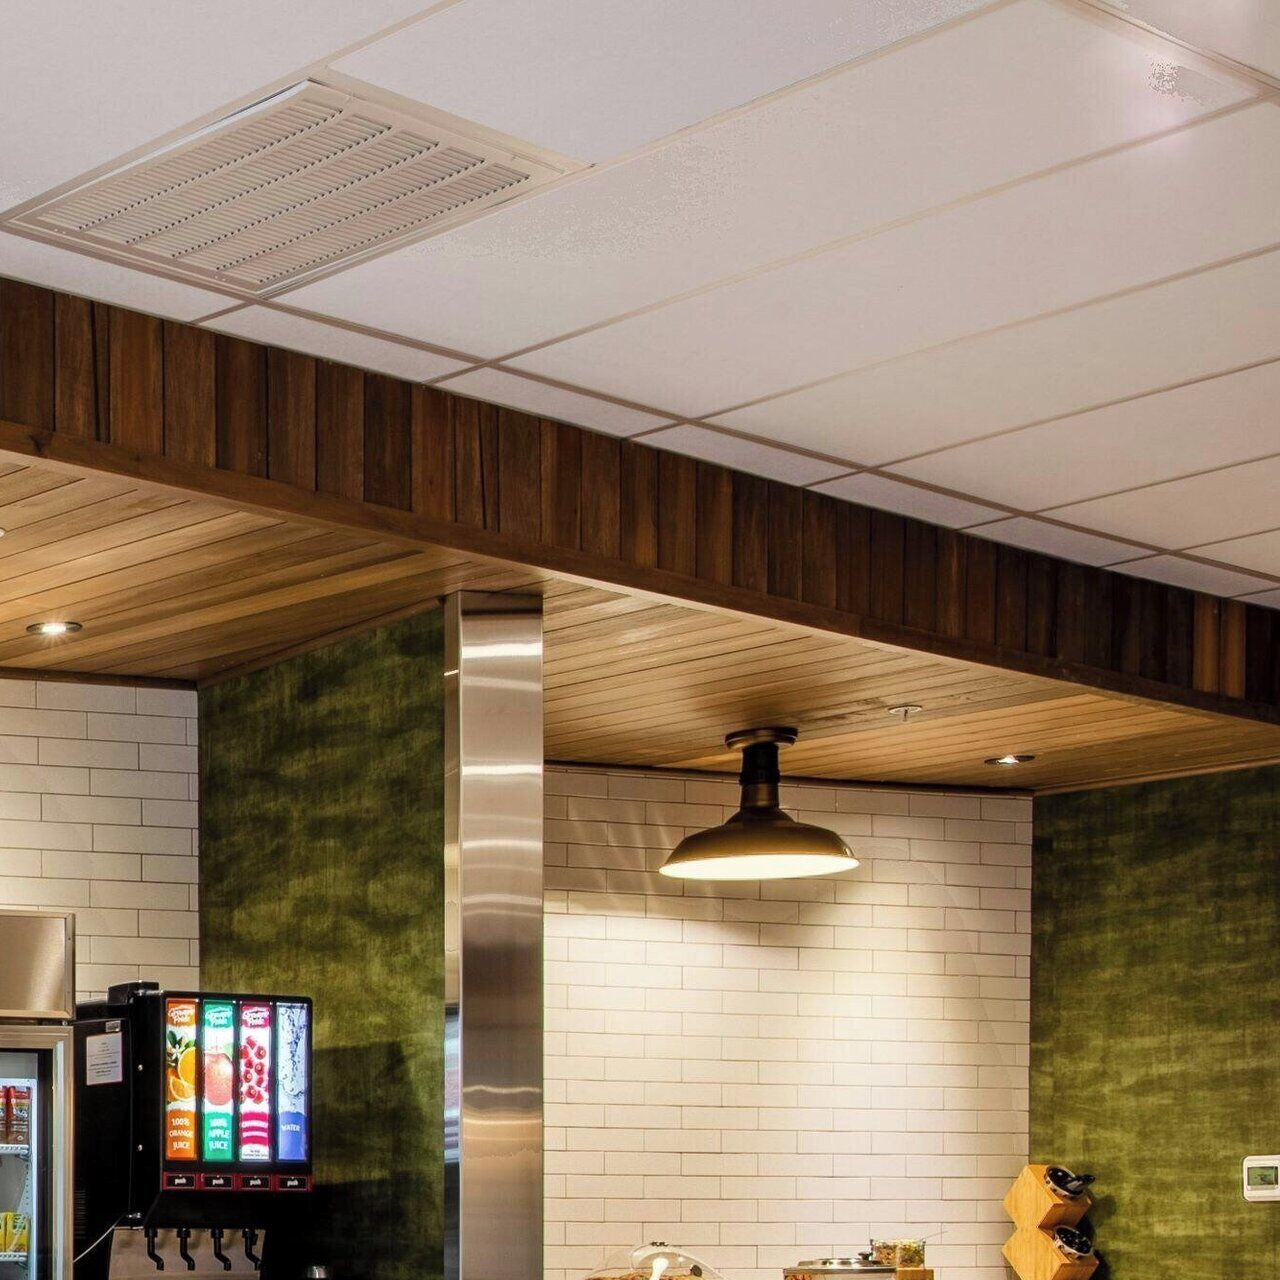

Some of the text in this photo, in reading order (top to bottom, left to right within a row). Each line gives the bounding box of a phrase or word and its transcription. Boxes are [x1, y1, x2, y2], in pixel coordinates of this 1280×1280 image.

[171, 1118, 190, 1126] 100%
[281, 1124, 300, 1132] WATER
[208, 1129, 231, 1138] APPLE
[173, 1141, 190, 1150] JUICE
[209, 1141, 228, 1150] JUICE
[174, 1177, 187, 1185] push
[212, 1178, 224, 1186] push
[250, 1179, 261, 1187] push
